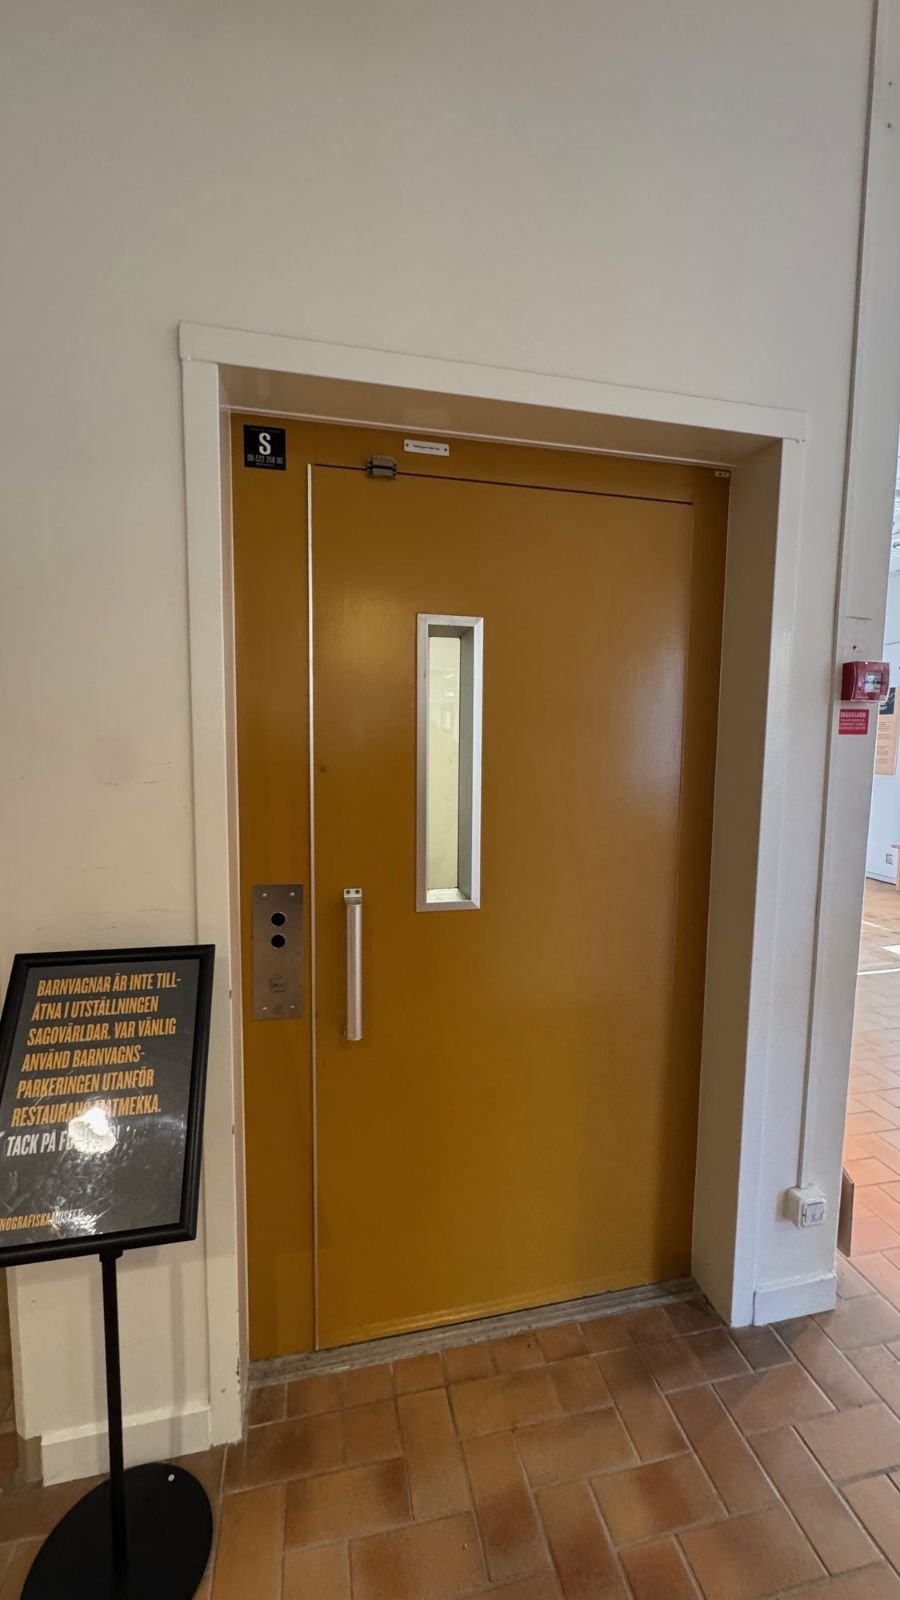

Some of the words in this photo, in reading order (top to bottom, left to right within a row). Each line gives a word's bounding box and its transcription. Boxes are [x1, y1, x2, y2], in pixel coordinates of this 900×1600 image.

[259, 432, 271, 455] S
[37, 976, 111, 997] BARNVAGNAR
[112, 973, 128, 992] ÄR
[129, 973, 153, 990] INTE
[156, 971, 182, 988] TILL-
[64, 1002, 70, 1019] I
[71, 996, 159, 1018] UTSTÄLLNINGEN
[27, 1021, 111, 1047] SAGOVÄRLDAR.
[114, 1022, 136, 1039] VAR
[138, 1017, 177, 1038] VÄNLIG
[21, 1048, 70, 1073] ANVÄND
[72, 1045, 145, 1067] BARNVAGNS-
[16, 1074, 100, 1099] PARKERINGEN
[102, 1066, 155, 1091] UTANFÖR
[6, 1136, 37, 1156] TACK
[41, 1128, 56, 1152] PÅ
